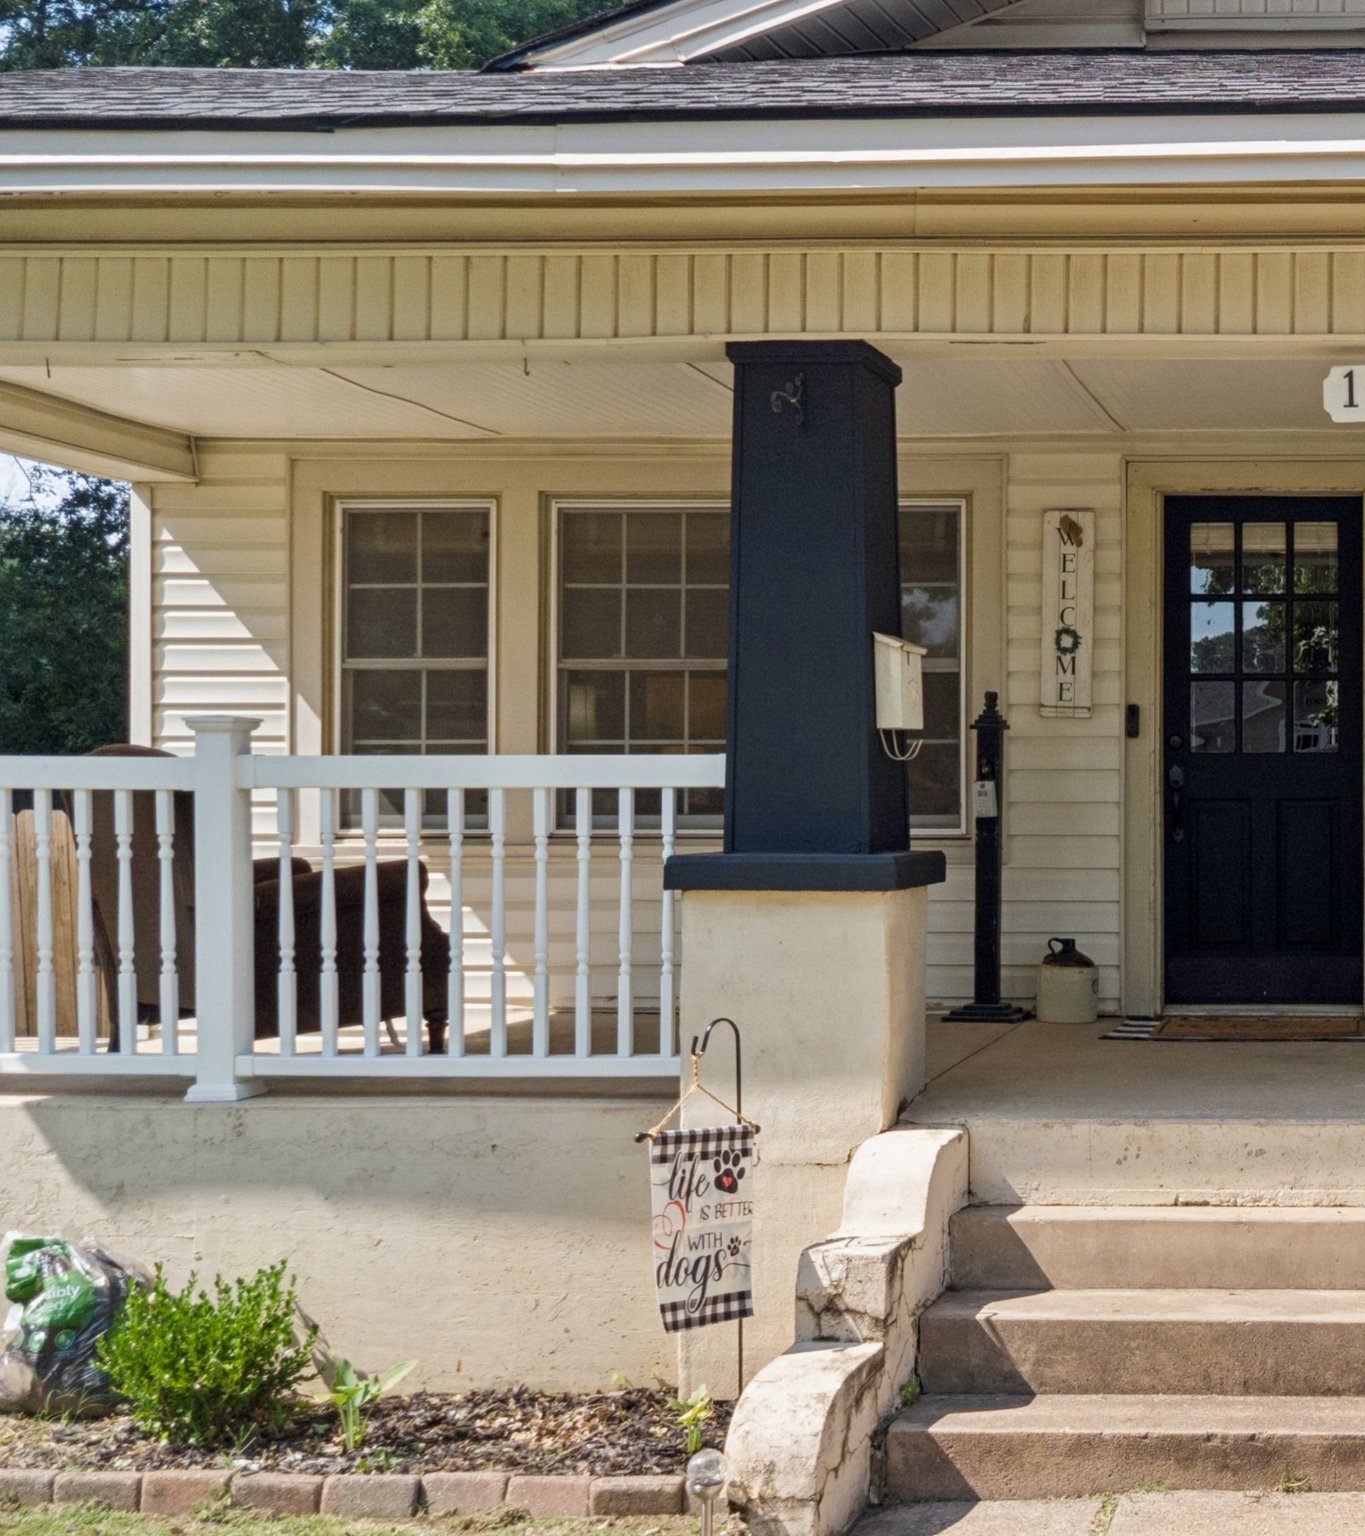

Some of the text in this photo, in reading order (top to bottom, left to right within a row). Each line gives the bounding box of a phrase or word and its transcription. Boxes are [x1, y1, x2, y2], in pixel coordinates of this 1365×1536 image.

[653, 1152, 710, 1213] life
[699, 1200, 753, 1220] IS BETTER
[687, 1231, 723, 1250] WITH
[656, 1230, 746, 1314] dogs
